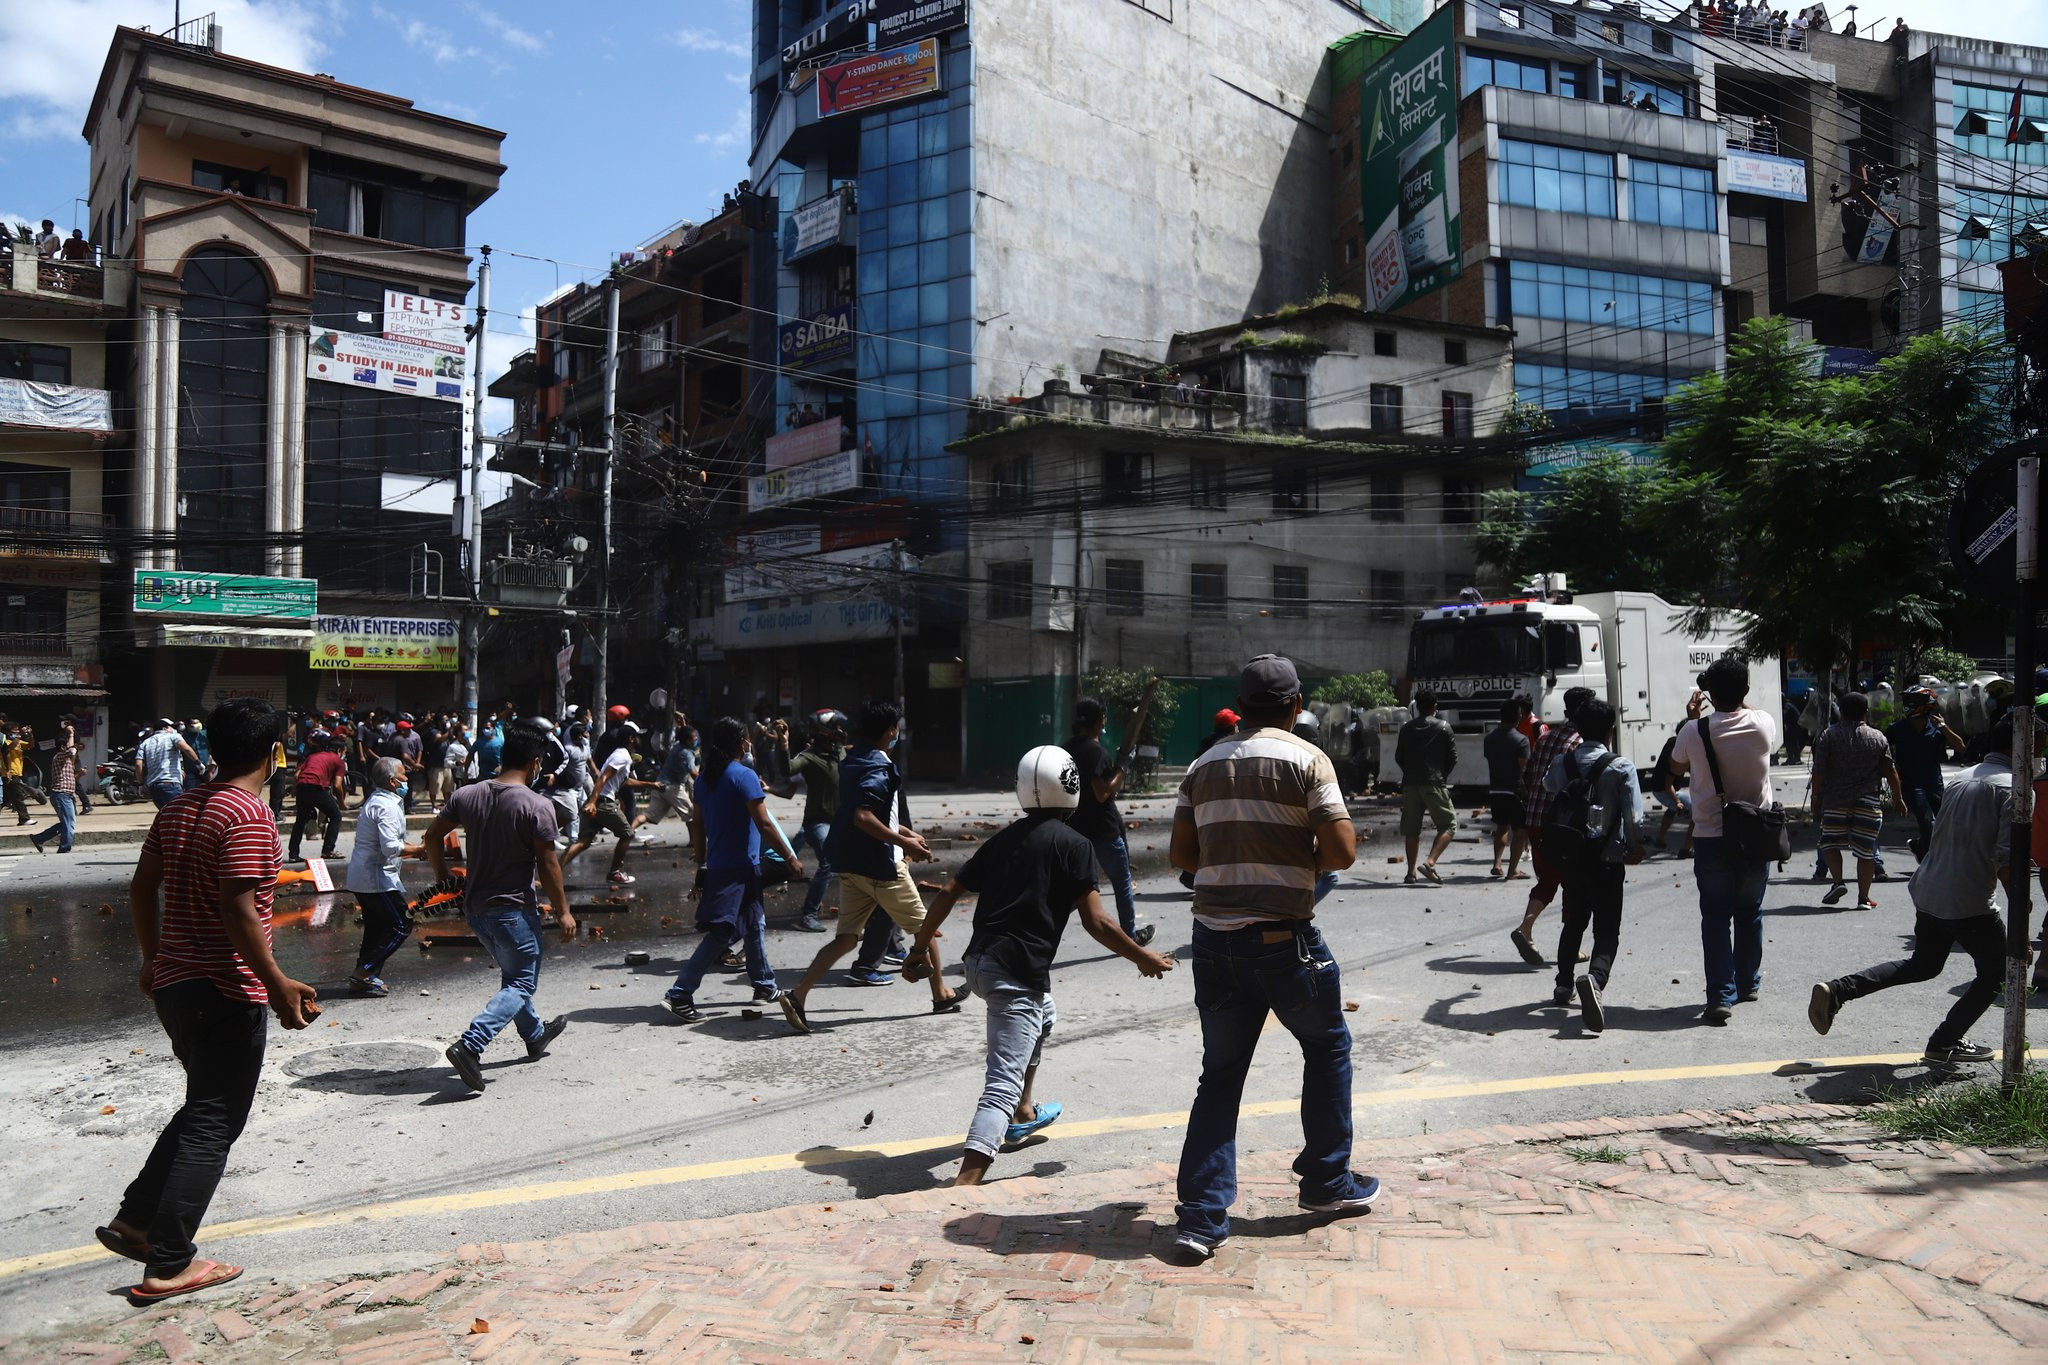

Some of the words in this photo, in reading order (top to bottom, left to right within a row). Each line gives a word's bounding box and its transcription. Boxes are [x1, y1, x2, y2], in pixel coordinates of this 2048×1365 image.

[879, 12, 908, 32] PROJECT
[909, 10, 914, 22] D
[915, 1, 942, 20] GAMING
[847, 63, 878, 79] Y-STAND
[878, 56, 903, 71] DANCE
[903, 48, 934, 64] SCHOOL
[1389, 45, 1448, 116] शिवम्
[1408, 228, 1425, 245] OPC
[391, 293, 461, 321] IELTS
[390, 311, 435, 327] JLPT/NAT
[390, 323, 405, 333] EPS
[409, 325, 433, 339] TOPIK
[343, 333, 365, 341] GREEN
[366, 336, 399, 348] PHEASANT
[400, 343, 434, 354] EDUCATION
[353, 341, 398, 354] CONSULTANCY
[336, 352, 377, 368] STUDY
[381, 361, 393, 371] IN
[396, 363, 433, 378] JAPAN
[768, 474, 785, 495] LIC
[756, 612, 776, 630] Kriti
[778, 609, 813, 631] Optical
[839, 605, 856, 623] THE
[858, 602, 878, 621] GIFT
[317, 617, 360, 634] KIRAN
[364, 619, 454, 637] ENTERPRISES
[312, 658, 351, 668] AKIYO
[1689, 652, 1714, 665] NEPAL
[1417, 680, 1457, 692] NEPAL
[1473, 678, 1522, 691] POLICE
